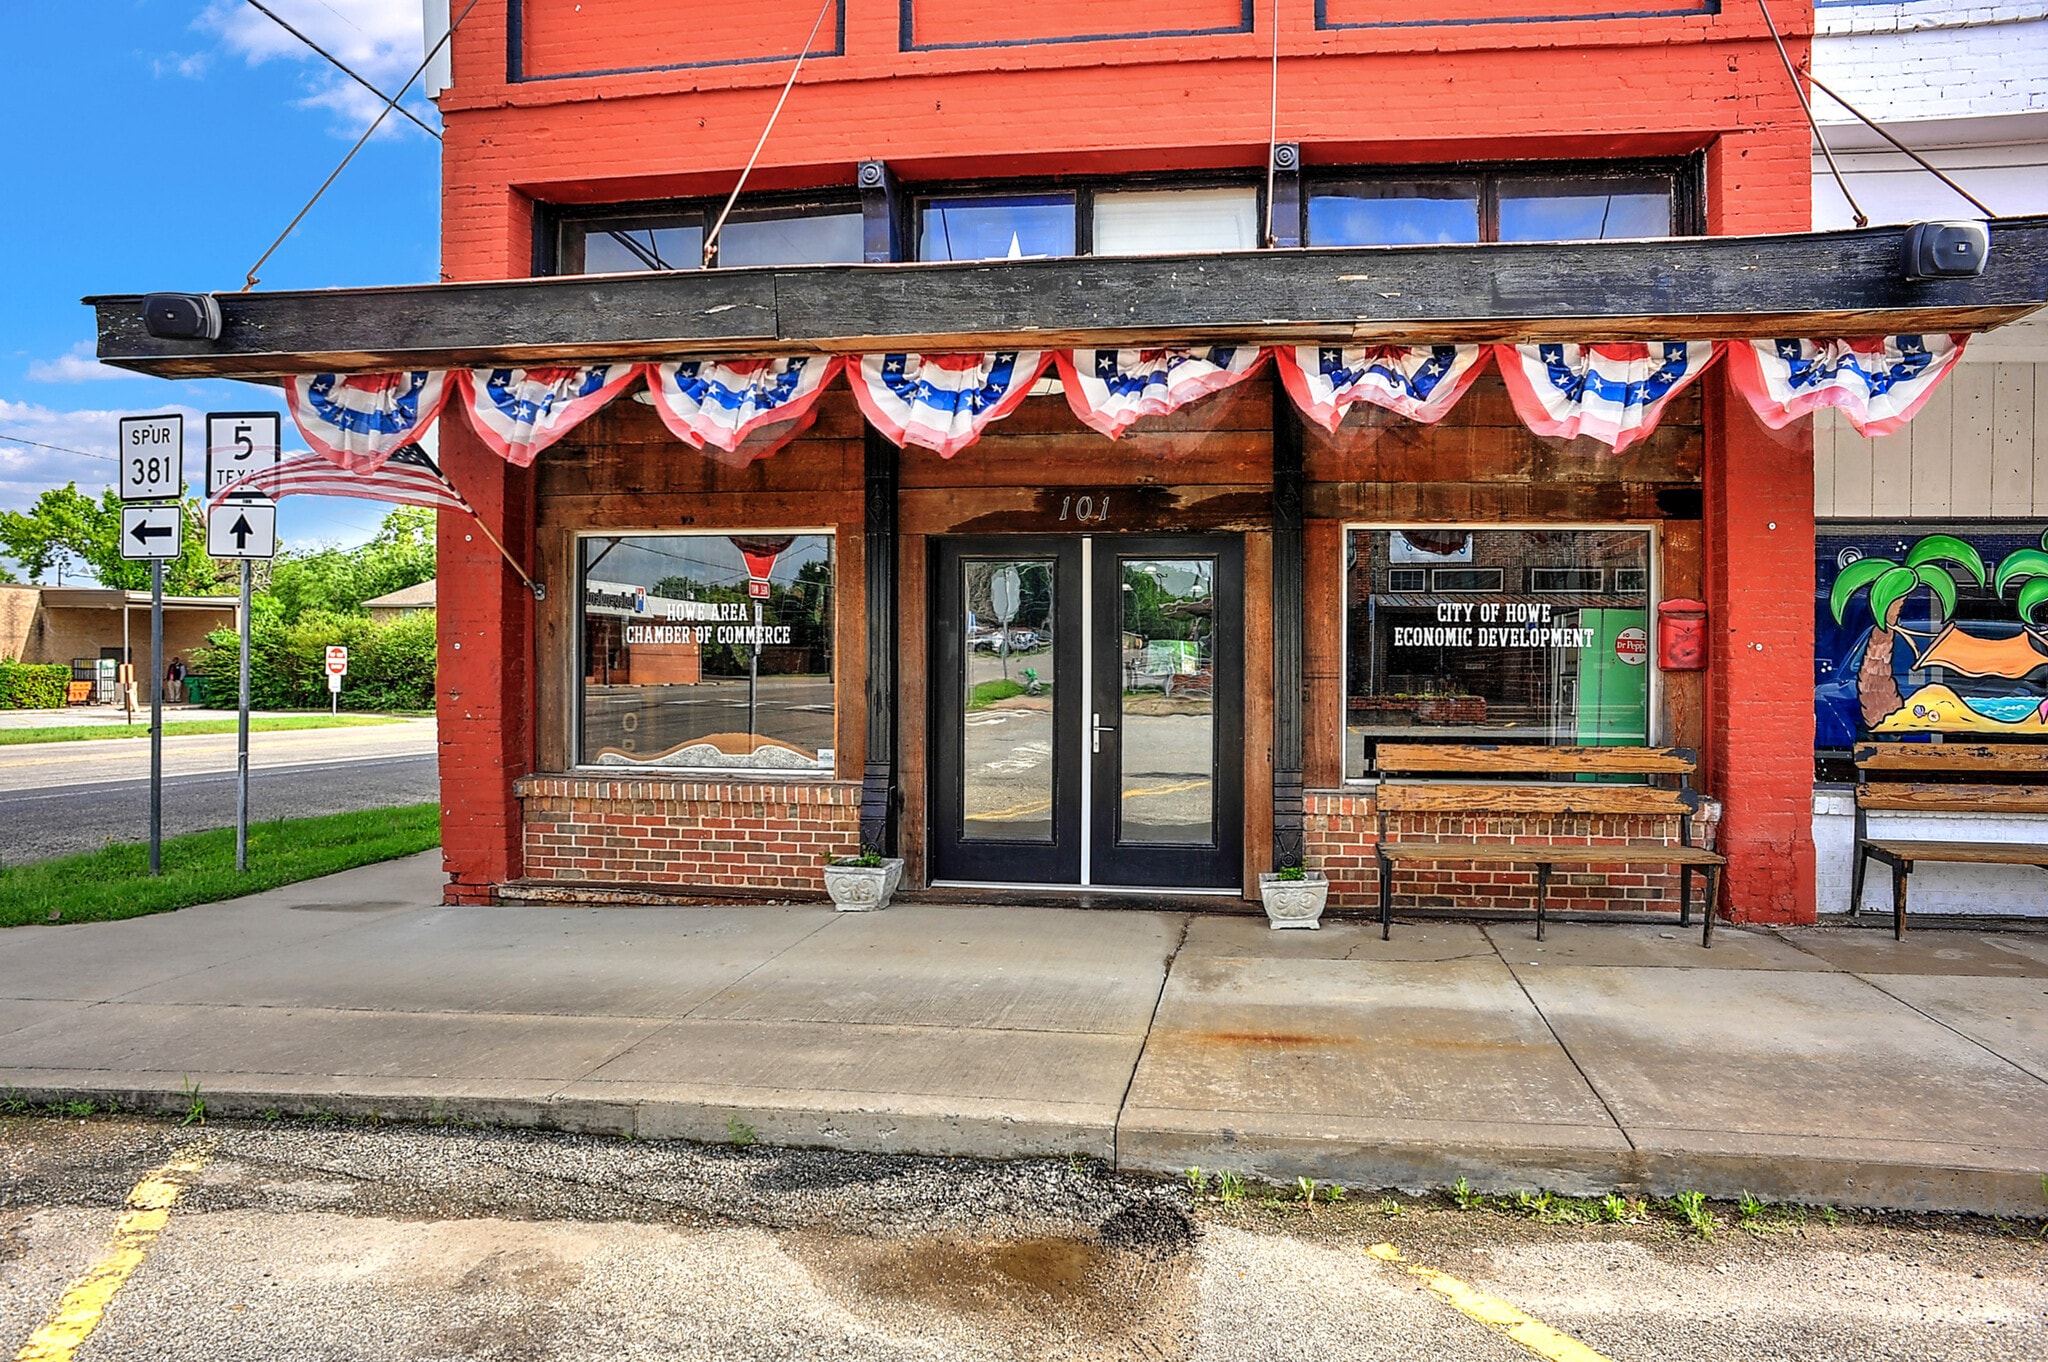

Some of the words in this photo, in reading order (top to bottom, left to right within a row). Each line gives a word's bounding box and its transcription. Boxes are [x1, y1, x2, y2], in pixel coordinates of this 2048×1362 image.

[132, 428, 171, 445] SPUR
[233, 426, 253, 461] 5
[132, 457, 170, 485] 381
[1059, 496, 1110, 521] 101
[666, 604, 705, 622] HOWE
[711, 604, 748, 622] AREA
[1437, 603, 1474, 622] CITY
[1480, 603, 1500, 622] OF
[1505, 603, 1551, 623] HOWE
[626, 626, 690, 644] CHAMBER
[695, 626, 713, 644] OF
[717, 626, 791, 644] COMMERCE
[1394, 627, 1472, 647] ECONOMIC
[1478, 627, 1594, 648] DEVELOPMENT
[1616, 641, 1626, 649] Dr
